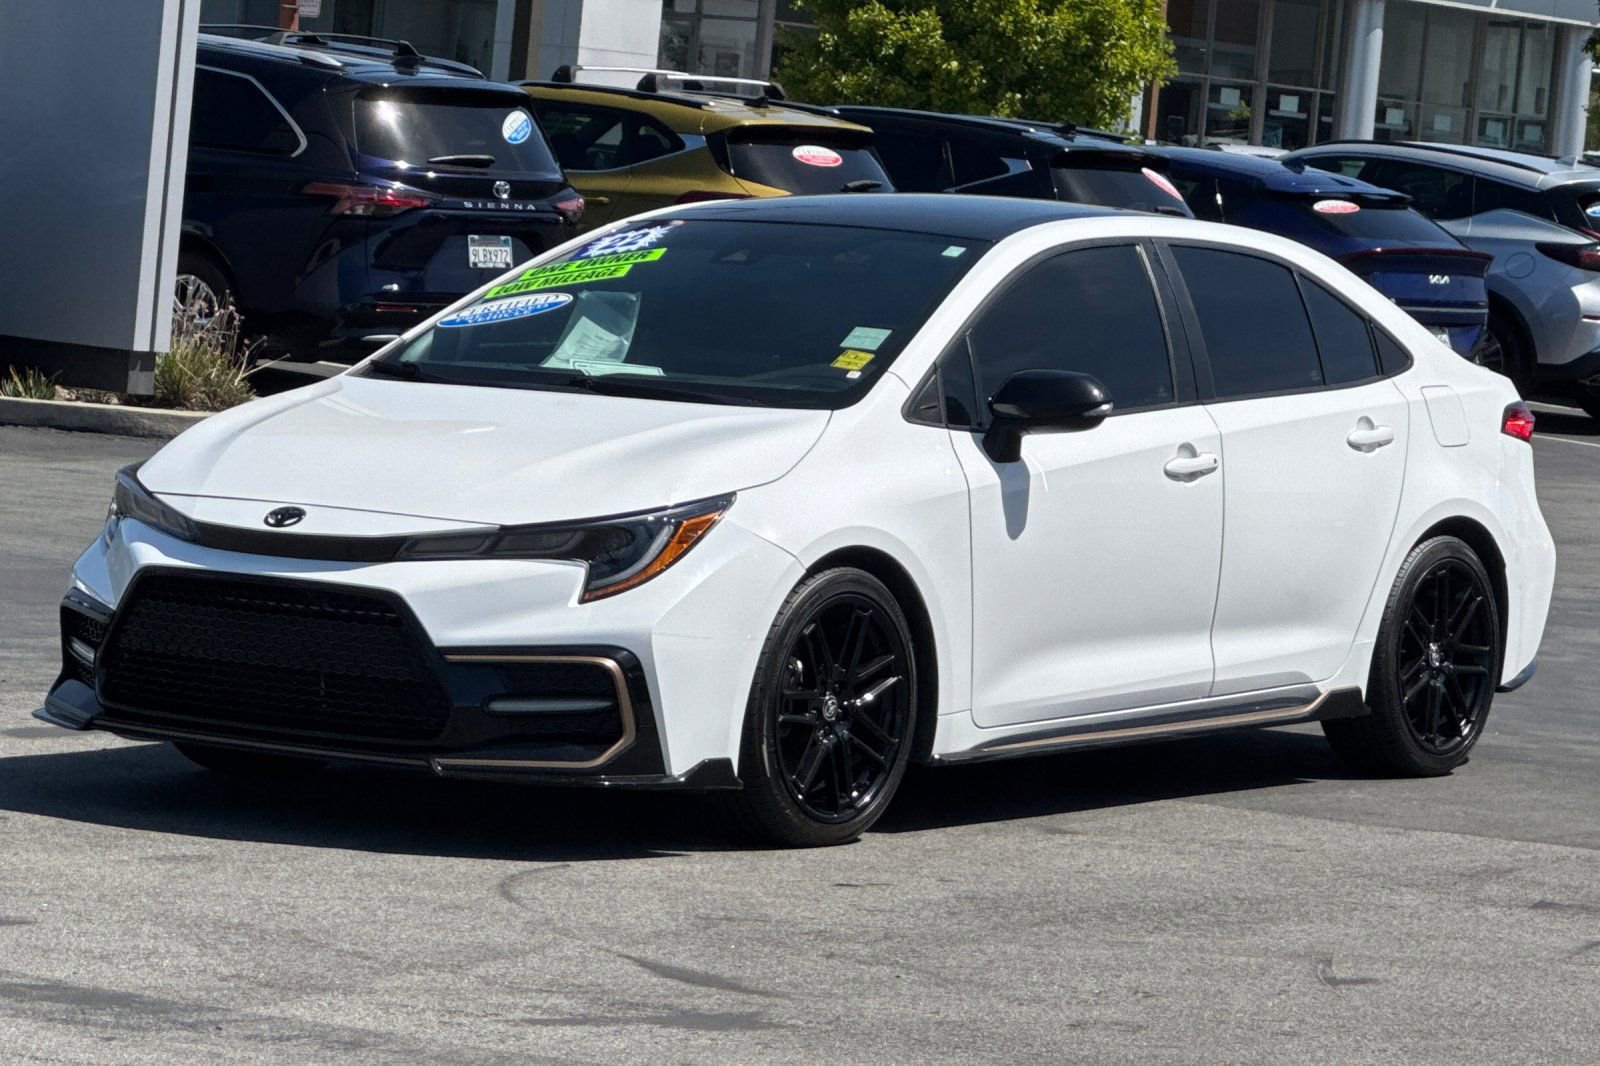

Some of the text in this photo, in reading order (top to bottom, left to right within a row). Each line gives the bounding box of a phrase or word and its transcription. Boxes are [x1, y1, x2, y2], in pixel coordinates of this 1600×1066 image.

[463, 201, 536, 211] SIENNA
[471, 248, 509, 263] 9LBX972
[528, 250, 653, 277] ONE OWNER
[493, 265, 626, 296] LOW MILEAGE
